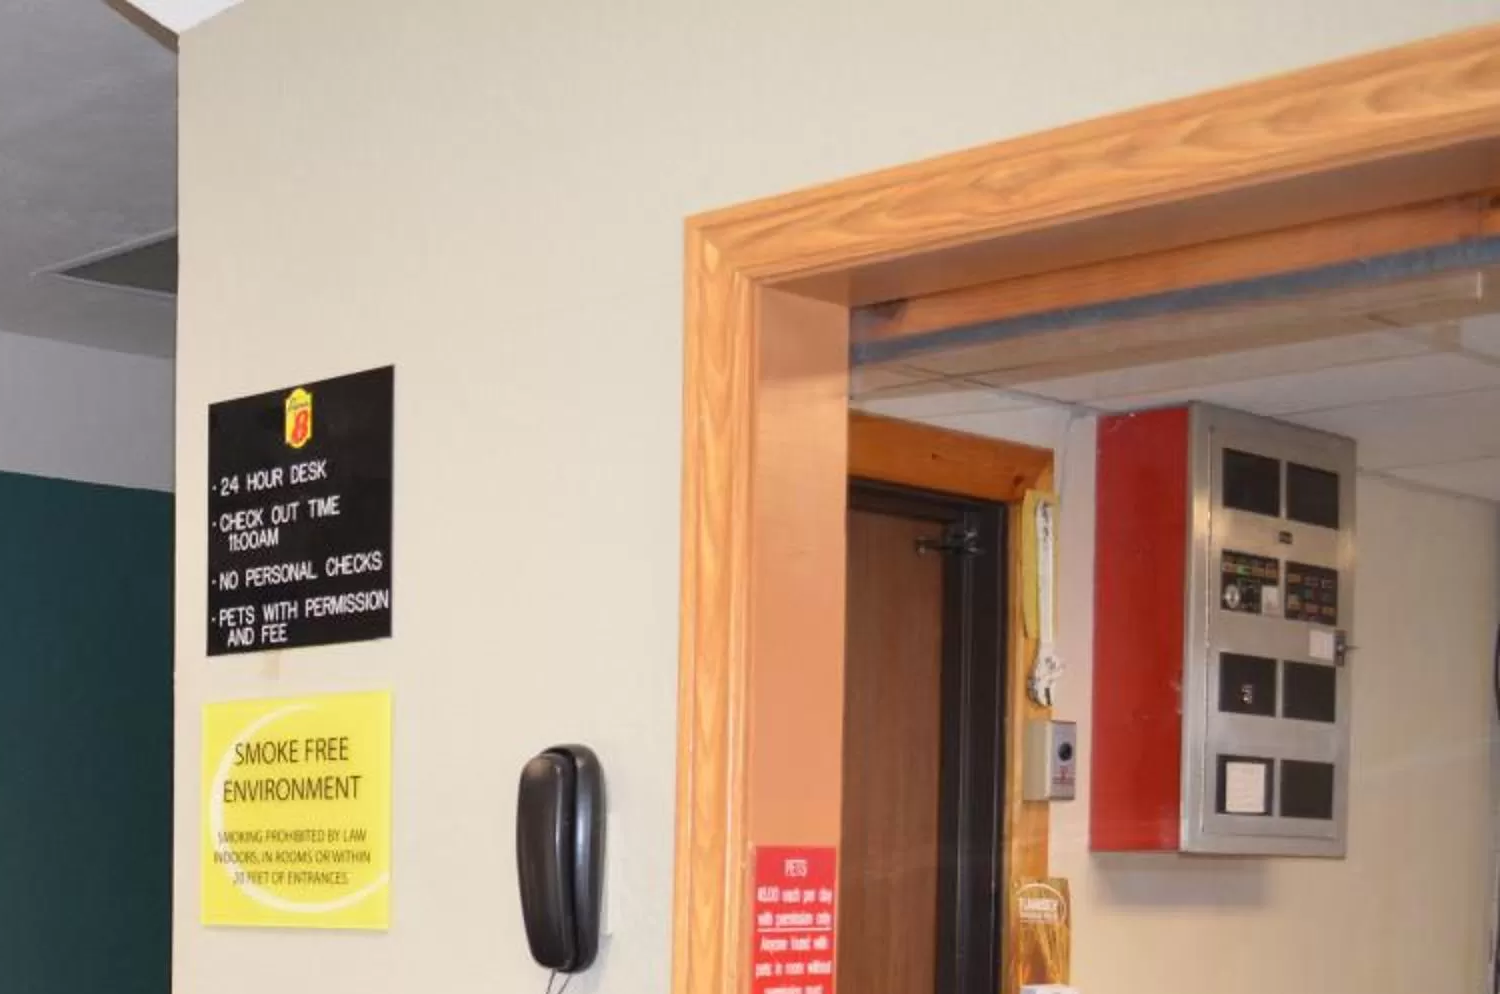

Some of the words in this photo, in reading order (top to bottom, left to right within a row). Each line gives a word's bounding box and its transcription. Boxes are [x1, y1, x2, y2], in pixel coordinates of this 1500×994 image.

[220, 476, 239, 497] 24
[247, 468, 283, 492] HOUR
[290, 459, 328, 484] DESK
[219, 509, 264, 533] CHECK
[271, 501, 300, 526] OUT
[308, 495, 341, 519] TIME
[228, 528, 279, 551] 11:00AM
[219, 572, 239, 591] NO
[245, 561, 319, 588] PERSONAL
[325, 550, 384, 577] CHECKS
[219, 605, 255, 627] PETS
[262, 600, 299, 623] WITH
[305, 590, 389, 618] PERMISSION
[227, 627, 254, 647] AND
[261, 623, 288, 643] FEE
[234, 739, 299, 766] SMOKE
[304, 736, 349, 763] FREE
[223, 775, 362, 803] ENVIRONMENT
[217, 830, 263, 844] SMOKING
[265, 829, 325, 843] PROHIBITED
[327, 828, 340, 843] BY
[343, 828, 367, 843] LAW
[262, 850, 274, 863] IN
[275, 850, 313, 864] ROOMS
[315, 851, 331, 863] OR
[332, 850, 371, 865] WITHIN
[271, 871, 285, 885] OF
